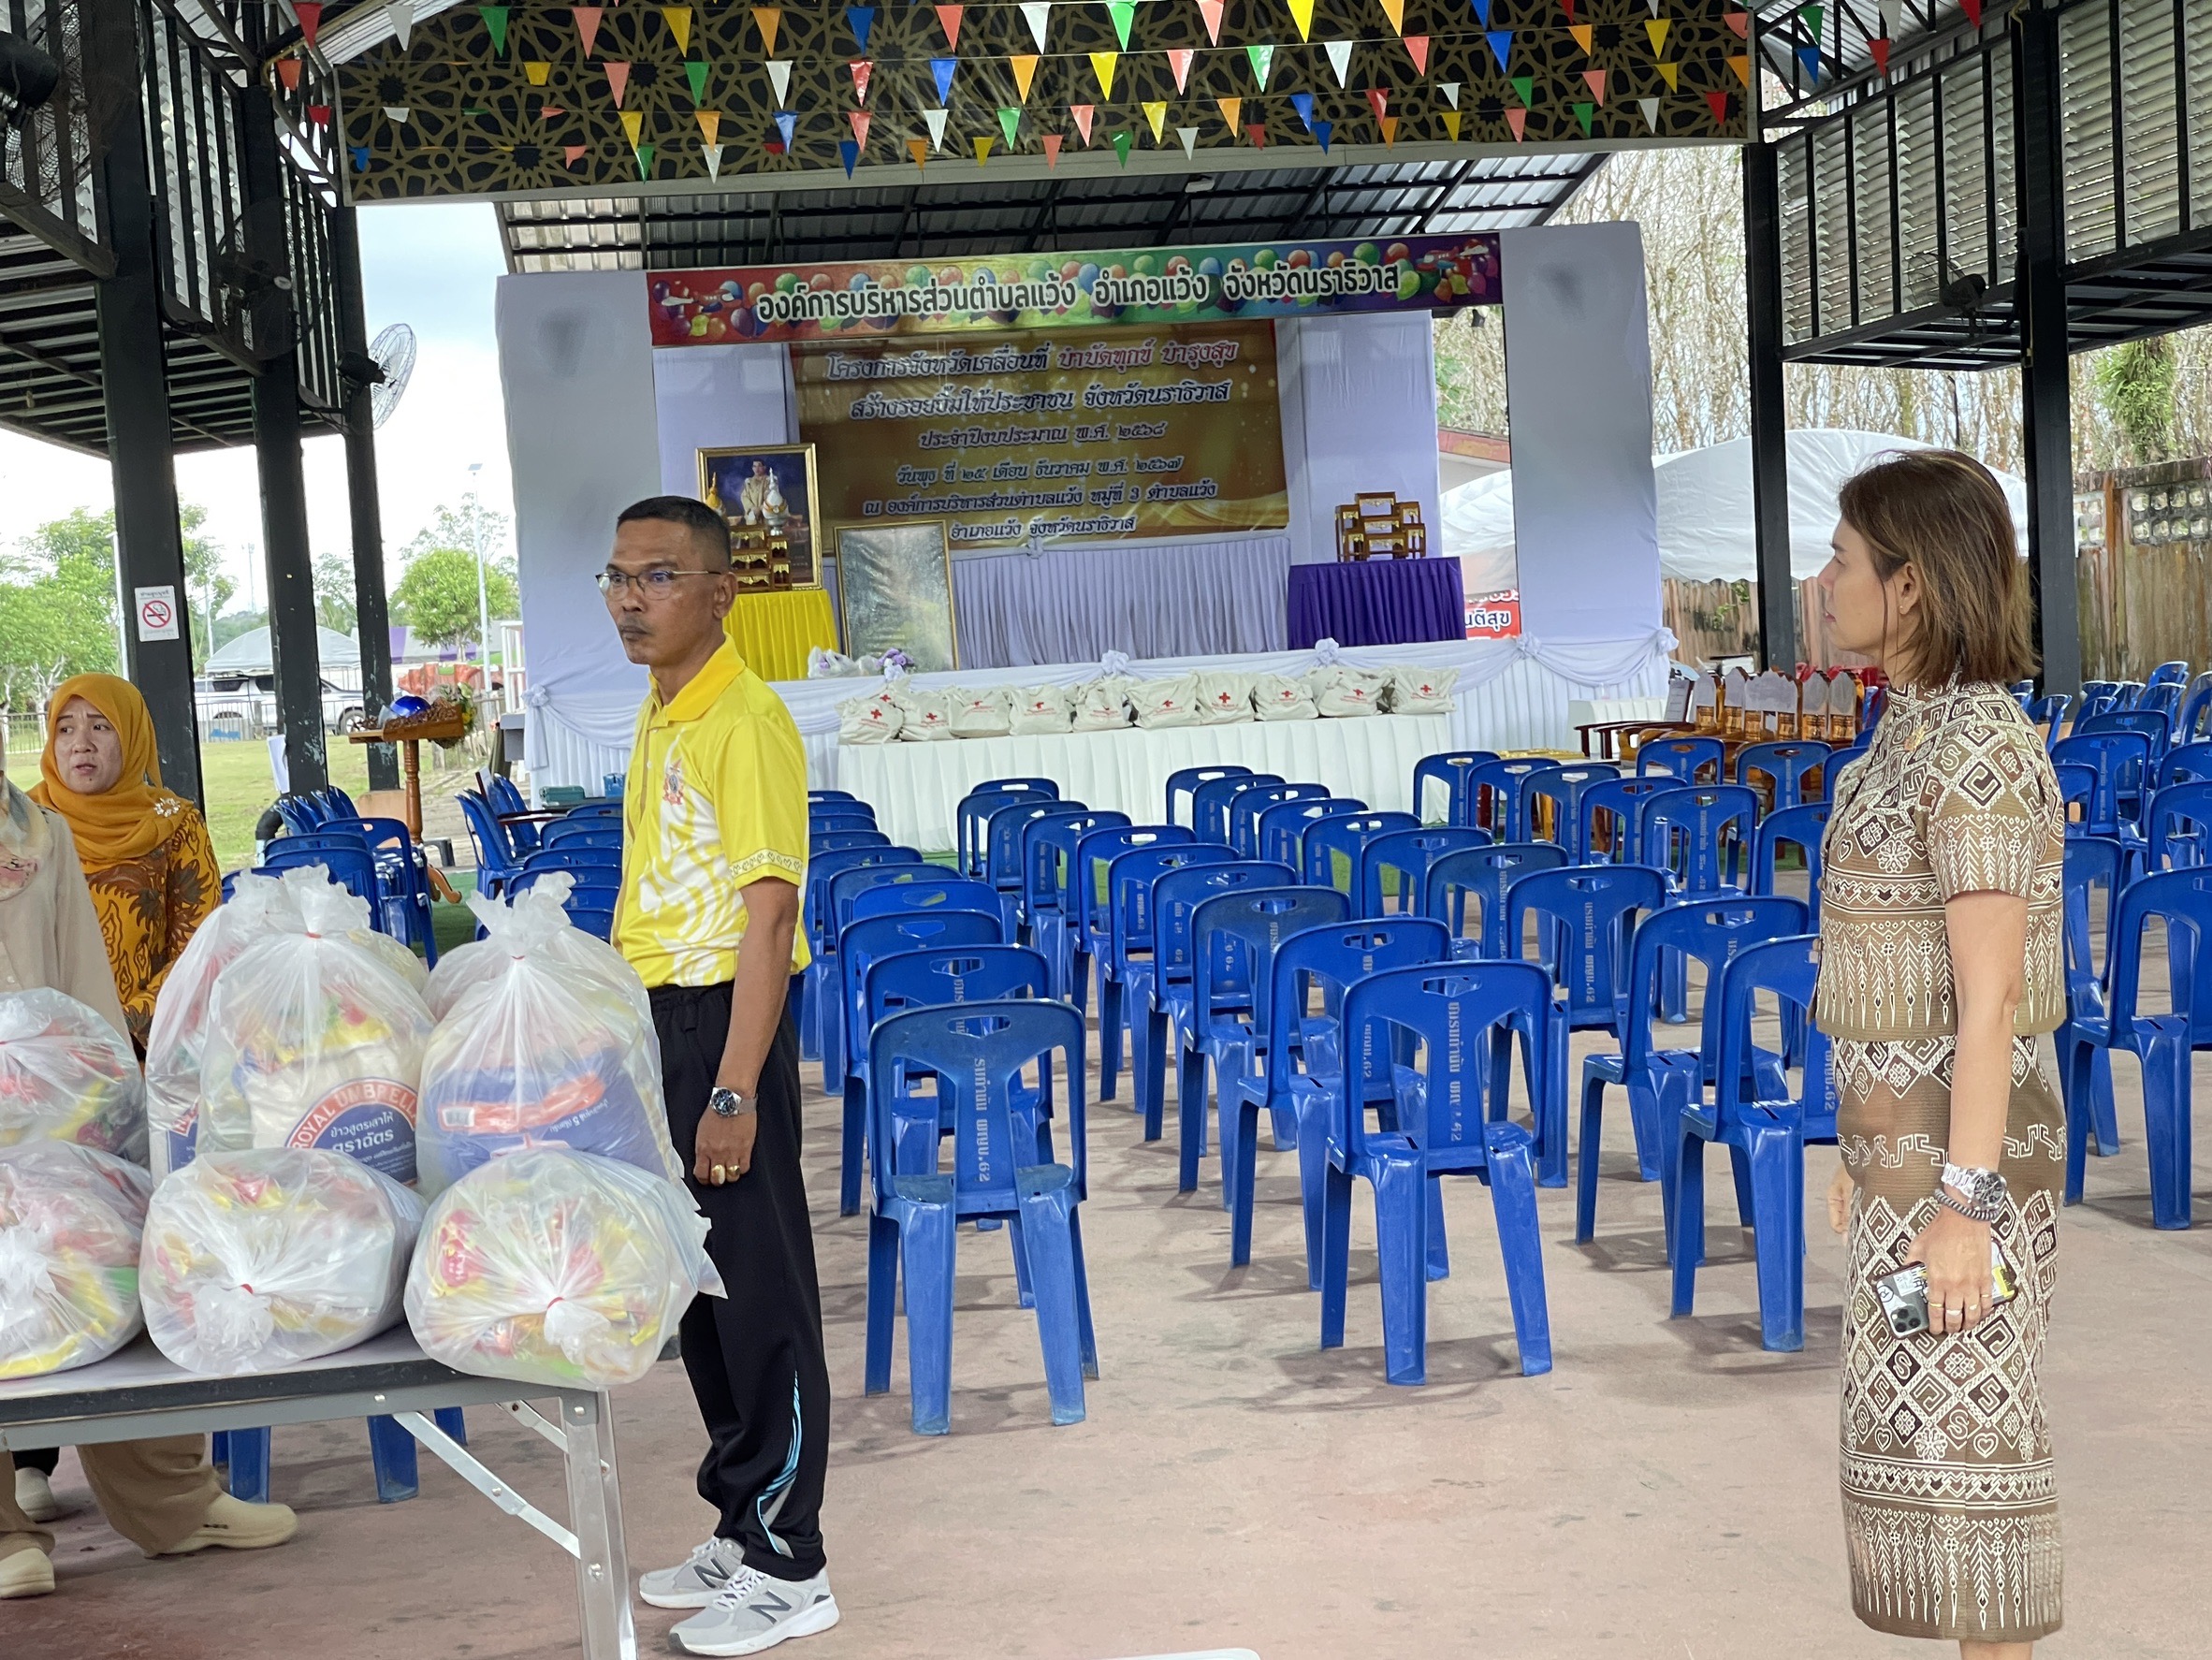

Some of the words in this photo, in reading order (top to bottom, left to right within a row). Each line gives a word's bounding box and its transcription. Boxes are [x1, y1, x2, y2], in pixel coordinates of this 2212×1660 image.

[757, 271, 1077, 321] องค์การบริหารส่วนตำบลแว้ง
[1095, 266, 1207, 305] อำเภอแว้ง
[1225, 261, 1400, 300] จังหวัดนราธิวาส
[828, 342, 1051, 380] โครงการจังหวัดเคลื่อนที่
[1058, 339, 1155, 372] บำบัดทุกข์
[1161, 341, 1238, 368] บำรุงสุข
[851, 386, 1074, 418] สร้างรอยยิ้มให้ประชาชน
[1084, 379, 1232, 407] จังหวัดนราธิวาส
[921, 426, 1067, 447] ประจำปีงบประมาณ
[1075, 424, 1109, 440] พ.ศ.
[897, 466, 937, 488] วันพุธ
[944, 460, 956, 481] ที่
[993, 460, 1028, 479] เดือน
[1035, 459, 1090, 476] ธันวาคม
[1098, 459, 1128, 473] พ.ศ.
[888, 486, 1084, 514] องค์การบริหารส่วนตำบลแว้ง
[1146, 479, 1217, 500] ตำบลแว้ง
[951, 518, 1022, 540] อำเภอแว้ง
[1029, 516, 1136, 535] จังหวัดนราธิวาส
[292, 1104, 337, 1149] ROYAL
[333, 1082, 417, 1120] UMBRELL
